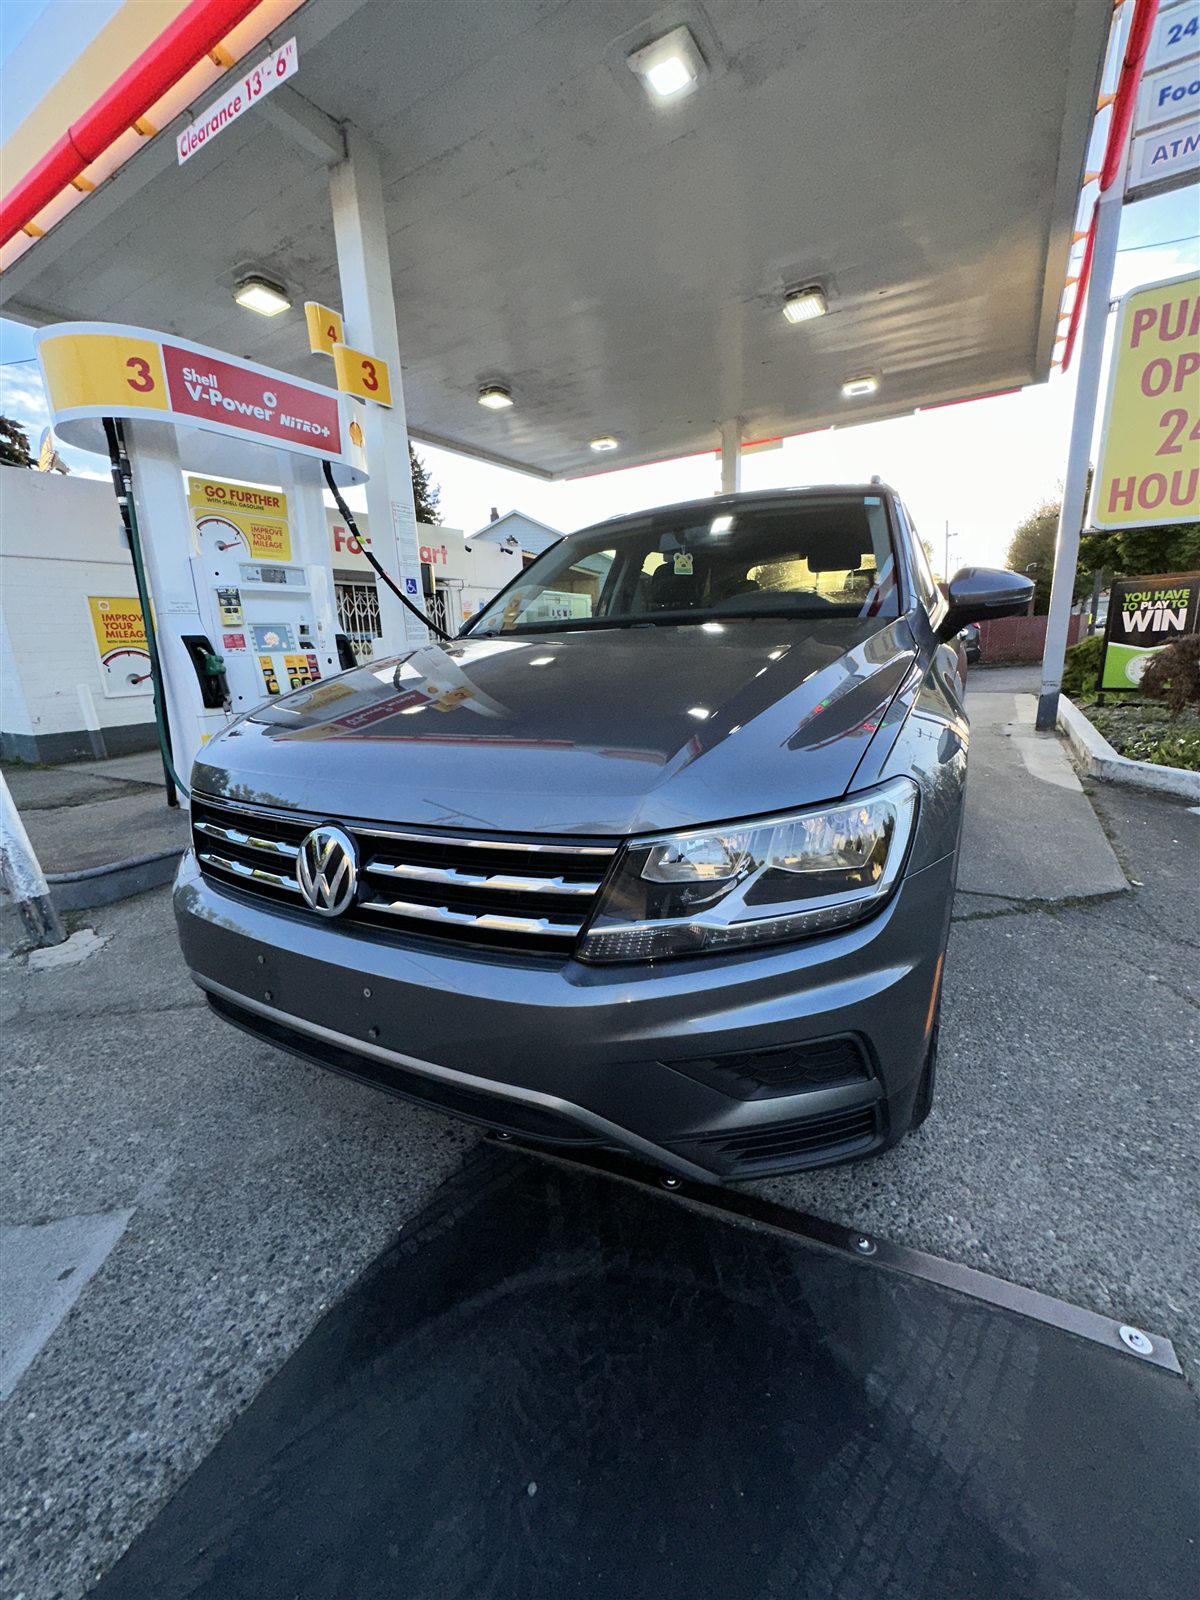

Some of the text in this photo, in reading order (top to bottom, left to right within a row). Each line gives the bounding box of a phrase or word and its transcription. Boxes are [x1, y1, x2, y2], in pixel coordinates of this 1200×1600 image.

[1167, 17, 1199, 46] 24
[1158, 81, 1200, 106] Foo
[180, 96, 242, 157] Clearance
[1152, 134, 1200, 165] ATM
[326, 325, 337, 342] 4
[126, 357, 155, 392] 3
[182, 367, 218, 388] Shell
[361, 360, 379, 391] 3
[184, 382, 272, 420] V-Power
[204, 485, 280, 508] GO FURTHER
[238, 502, 264, 511] GASOLINE
[251, 526, 283, 536] IMPROVE
[252, 533, 272, 541] YOUR
[253, 540, 283, 549] MILEAGE
[332, 525, 448, 564] Fo art
[1122, 599, 1188, 611] TO PLAY TO
[1124, 589, 1190, 602] YOU HAVE
[101, 614, 143, 622] IMPROV
[103, 622, 134, 630] YOUR
[1122, 608, 1187, 633] WIN
[106, 630, 147, 638] MILEAG
